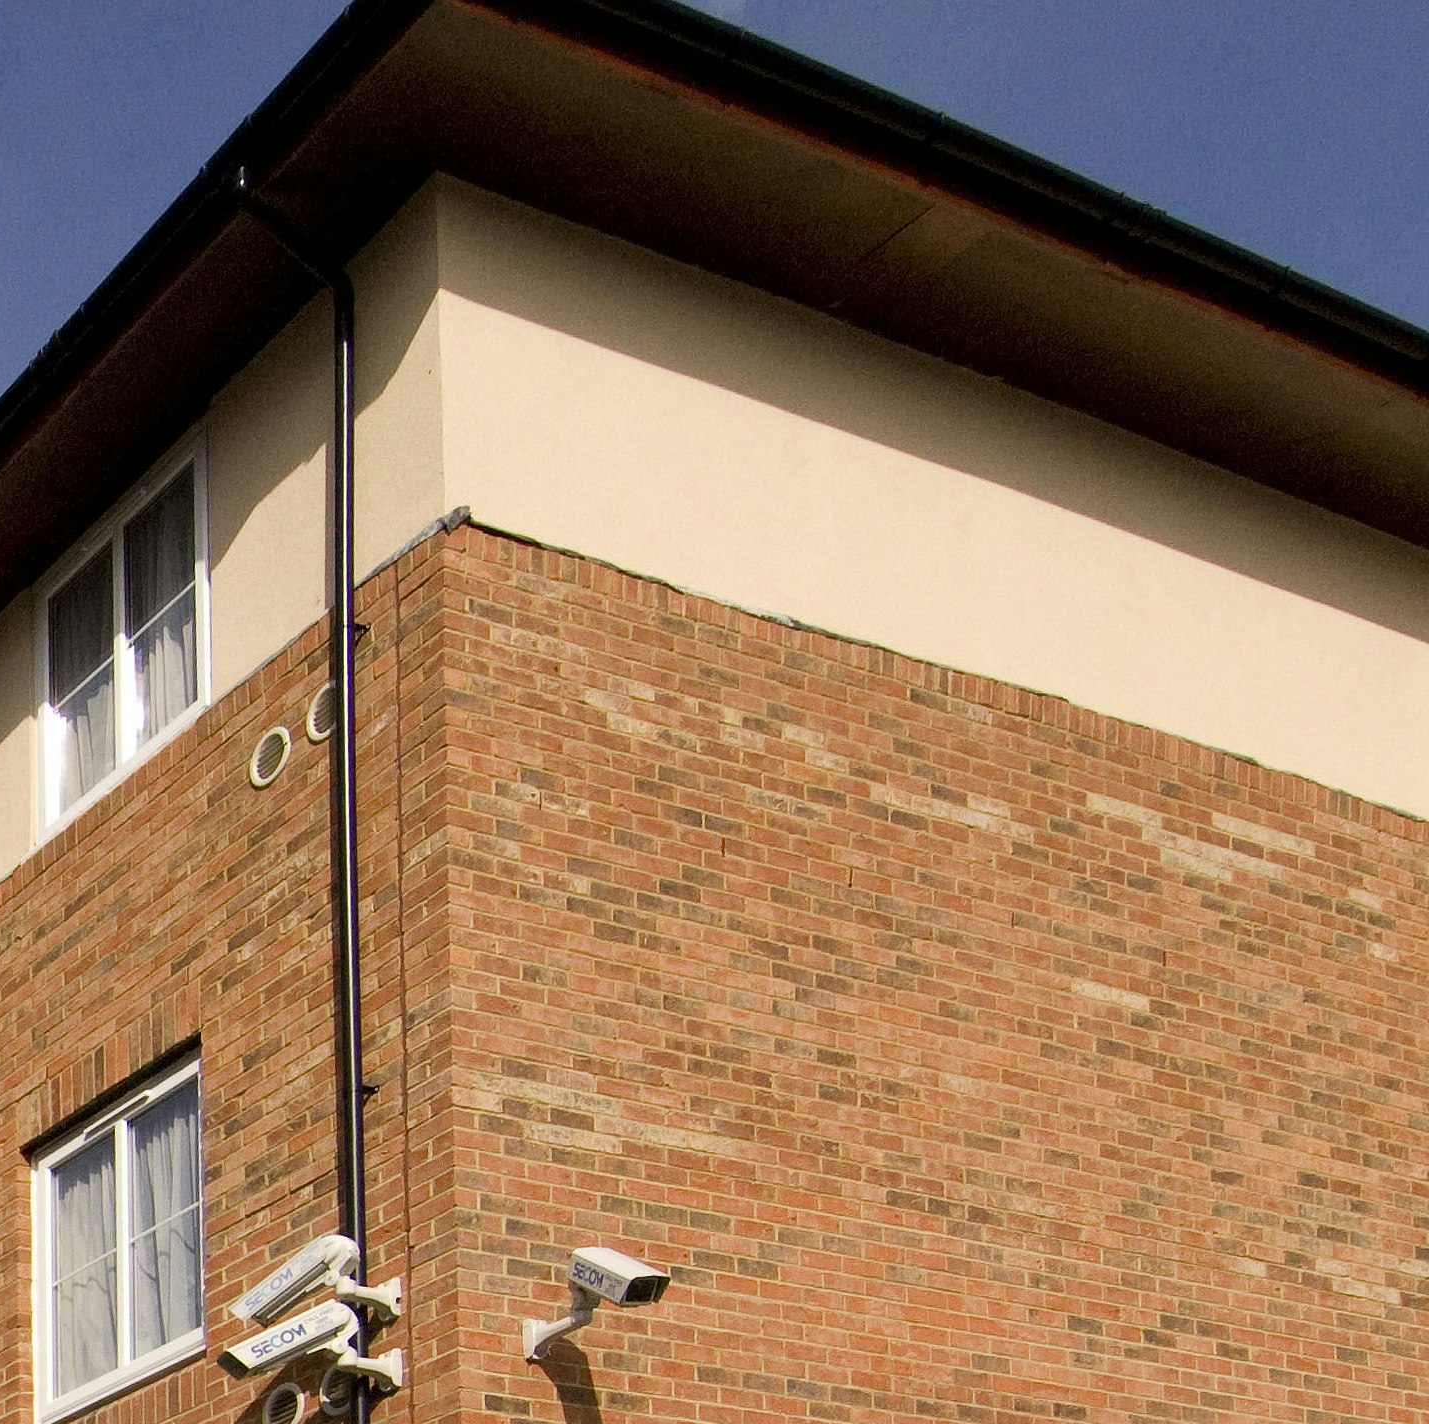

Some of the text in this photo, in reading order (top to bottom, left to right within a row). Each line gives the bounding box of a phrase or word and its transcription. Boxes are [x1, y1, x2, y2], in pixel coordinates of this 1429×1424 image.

[245, 1267, 294, 1311] SECOM
[572, 1262, 605, 1288] SECOM
[251, 1323, 307, 1359] SECOM
